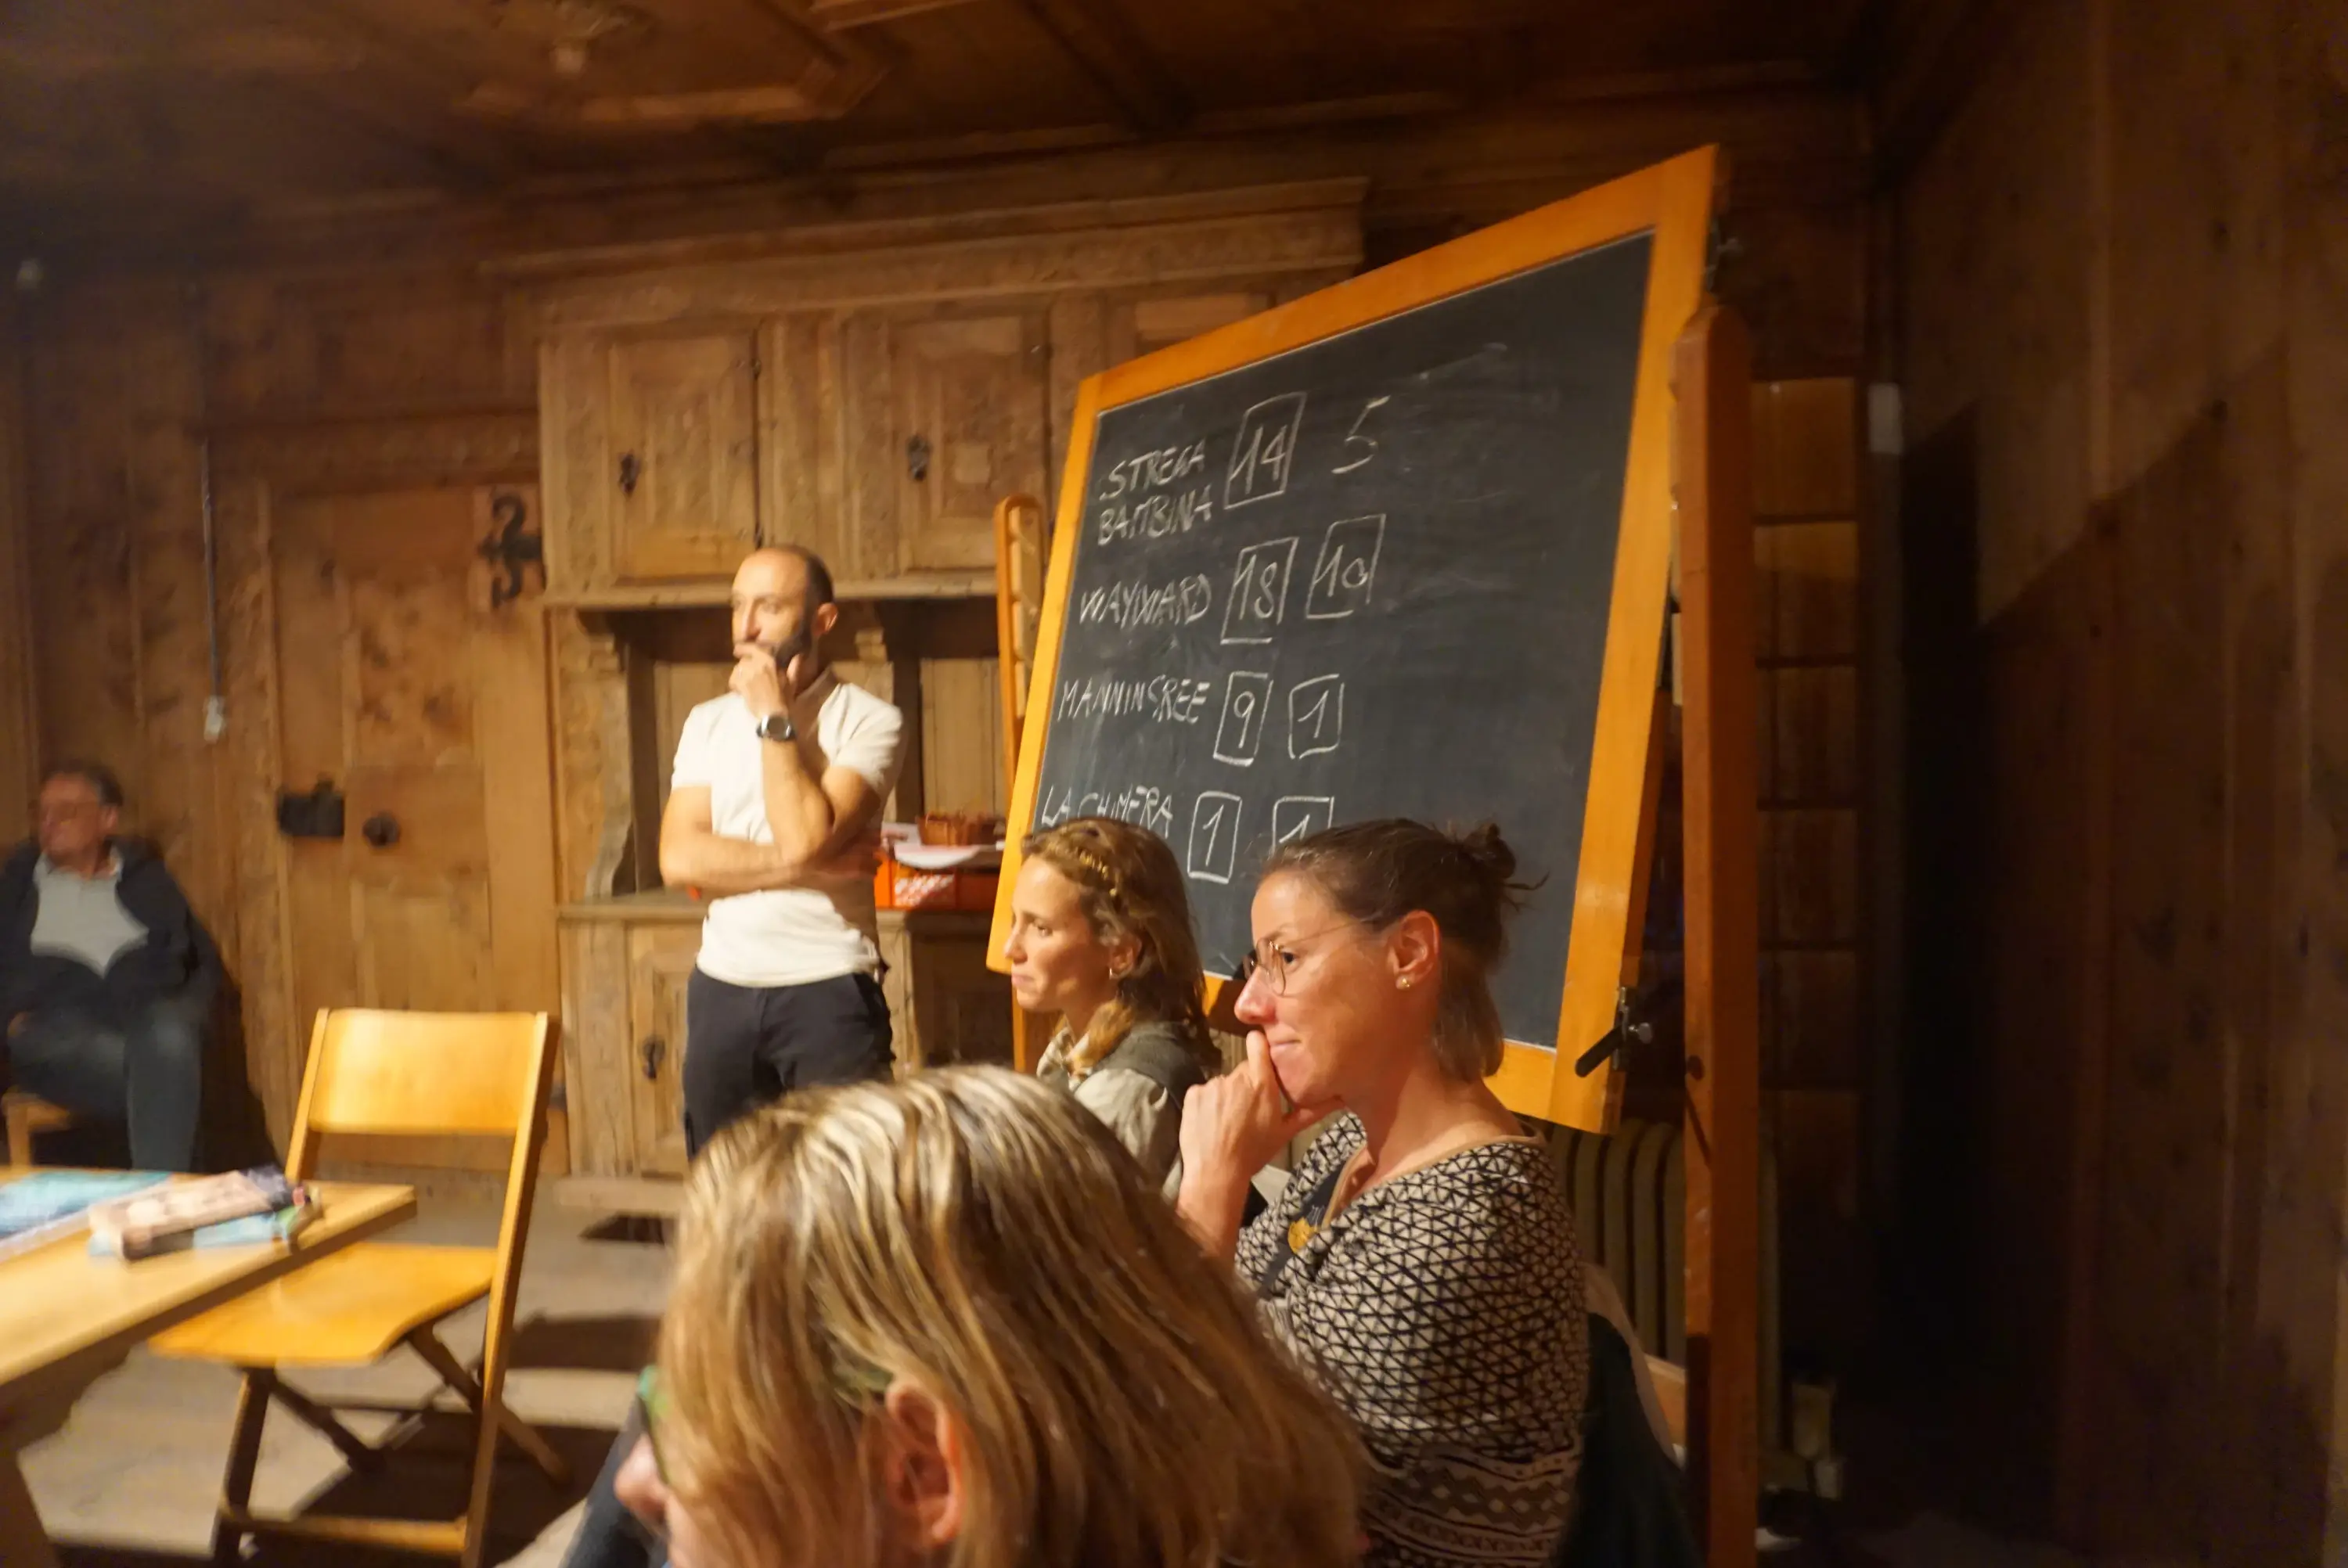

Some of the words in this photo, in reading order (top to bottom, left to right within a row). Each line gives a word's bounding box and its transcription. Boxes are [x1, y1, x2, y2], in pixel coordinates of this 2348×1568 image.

[1230, 425, 1287, 494] 14
[1333, 396, 1391, 473] 5
[1233, 554, 1277, 620] 18
[1313, 545, 1369, 597] 10
[1079, 573, 1212, 629] WAYWARD
[1233, 691, 1255, 749] 9
[1298, 689, 1330, 739] 1
[1041, 784, 1072, 827] LA
[1203, 804, 1224, 866] 1
